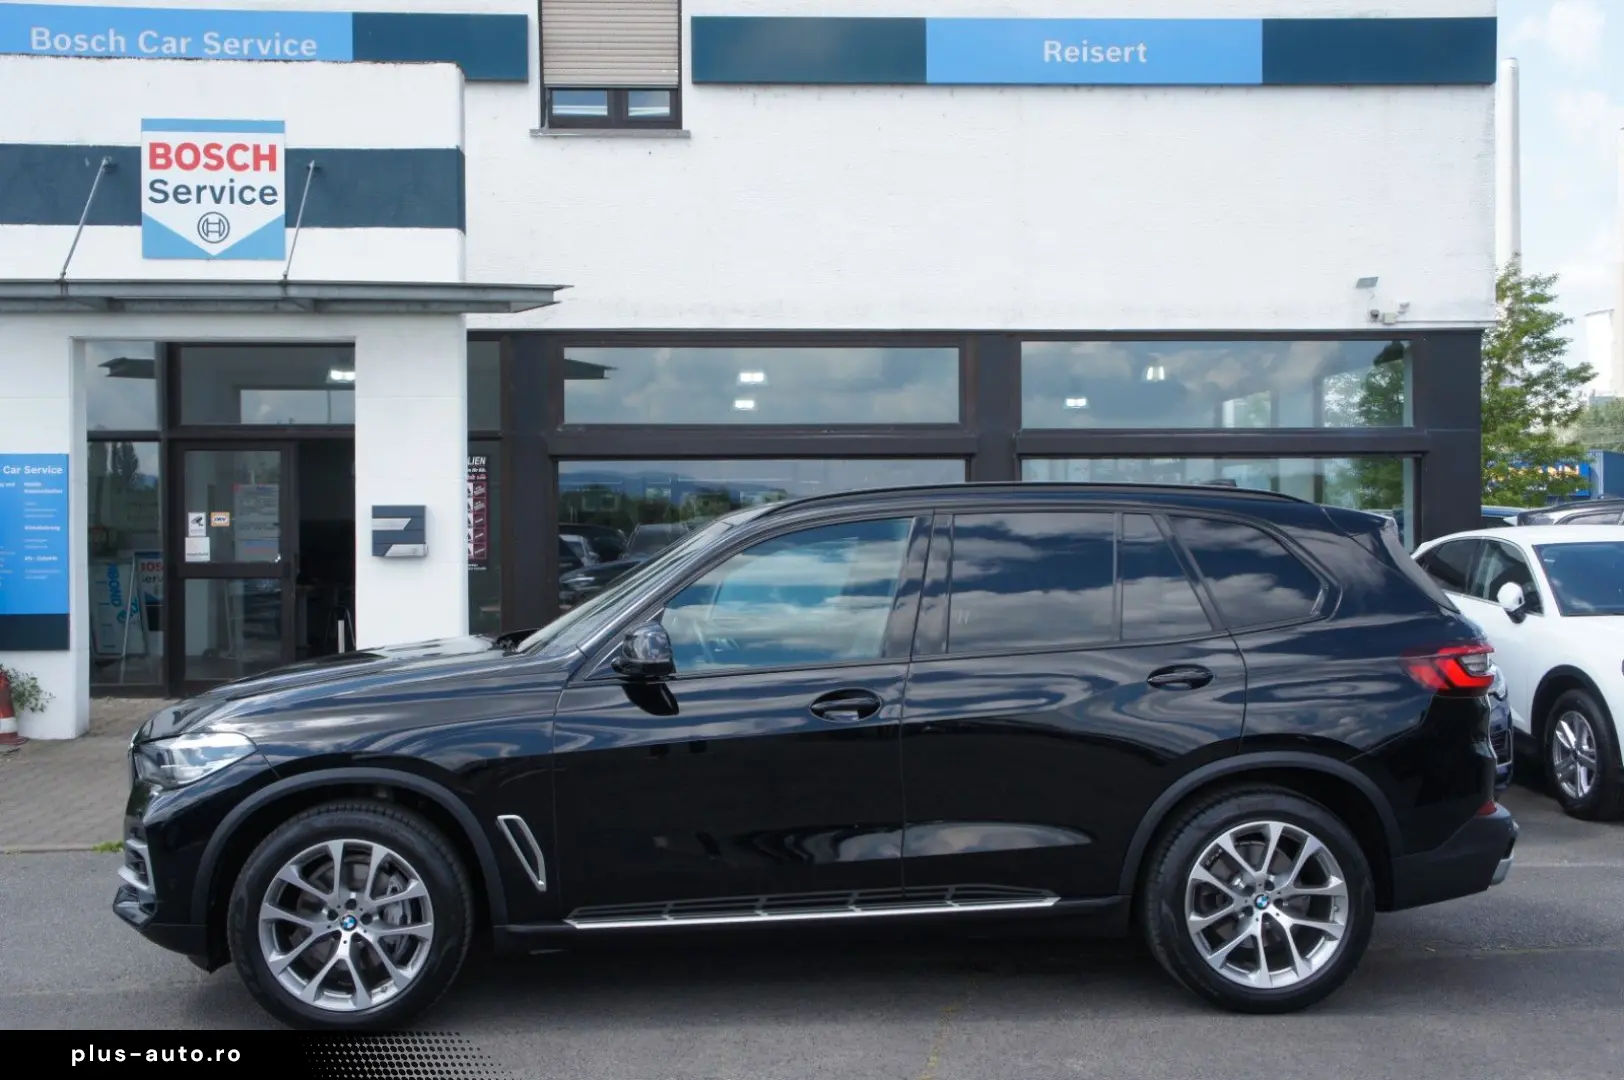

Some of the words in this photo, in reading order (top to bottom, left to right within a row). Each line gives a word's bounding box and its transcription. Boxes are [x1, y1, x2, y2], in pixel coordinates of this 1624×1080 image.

[30, 27, 127, 54] Bosch
[138, 30, 192, 55] Car
[203, 33, 318, 57] Service
[1043, 39, 1148, 64] Reisert
[148, 142, 278, 173] BOSCH
[148, 179, 278, 206] Service
[3, 466, 21, 475] Car
[24, 465, 63, 475] Service
